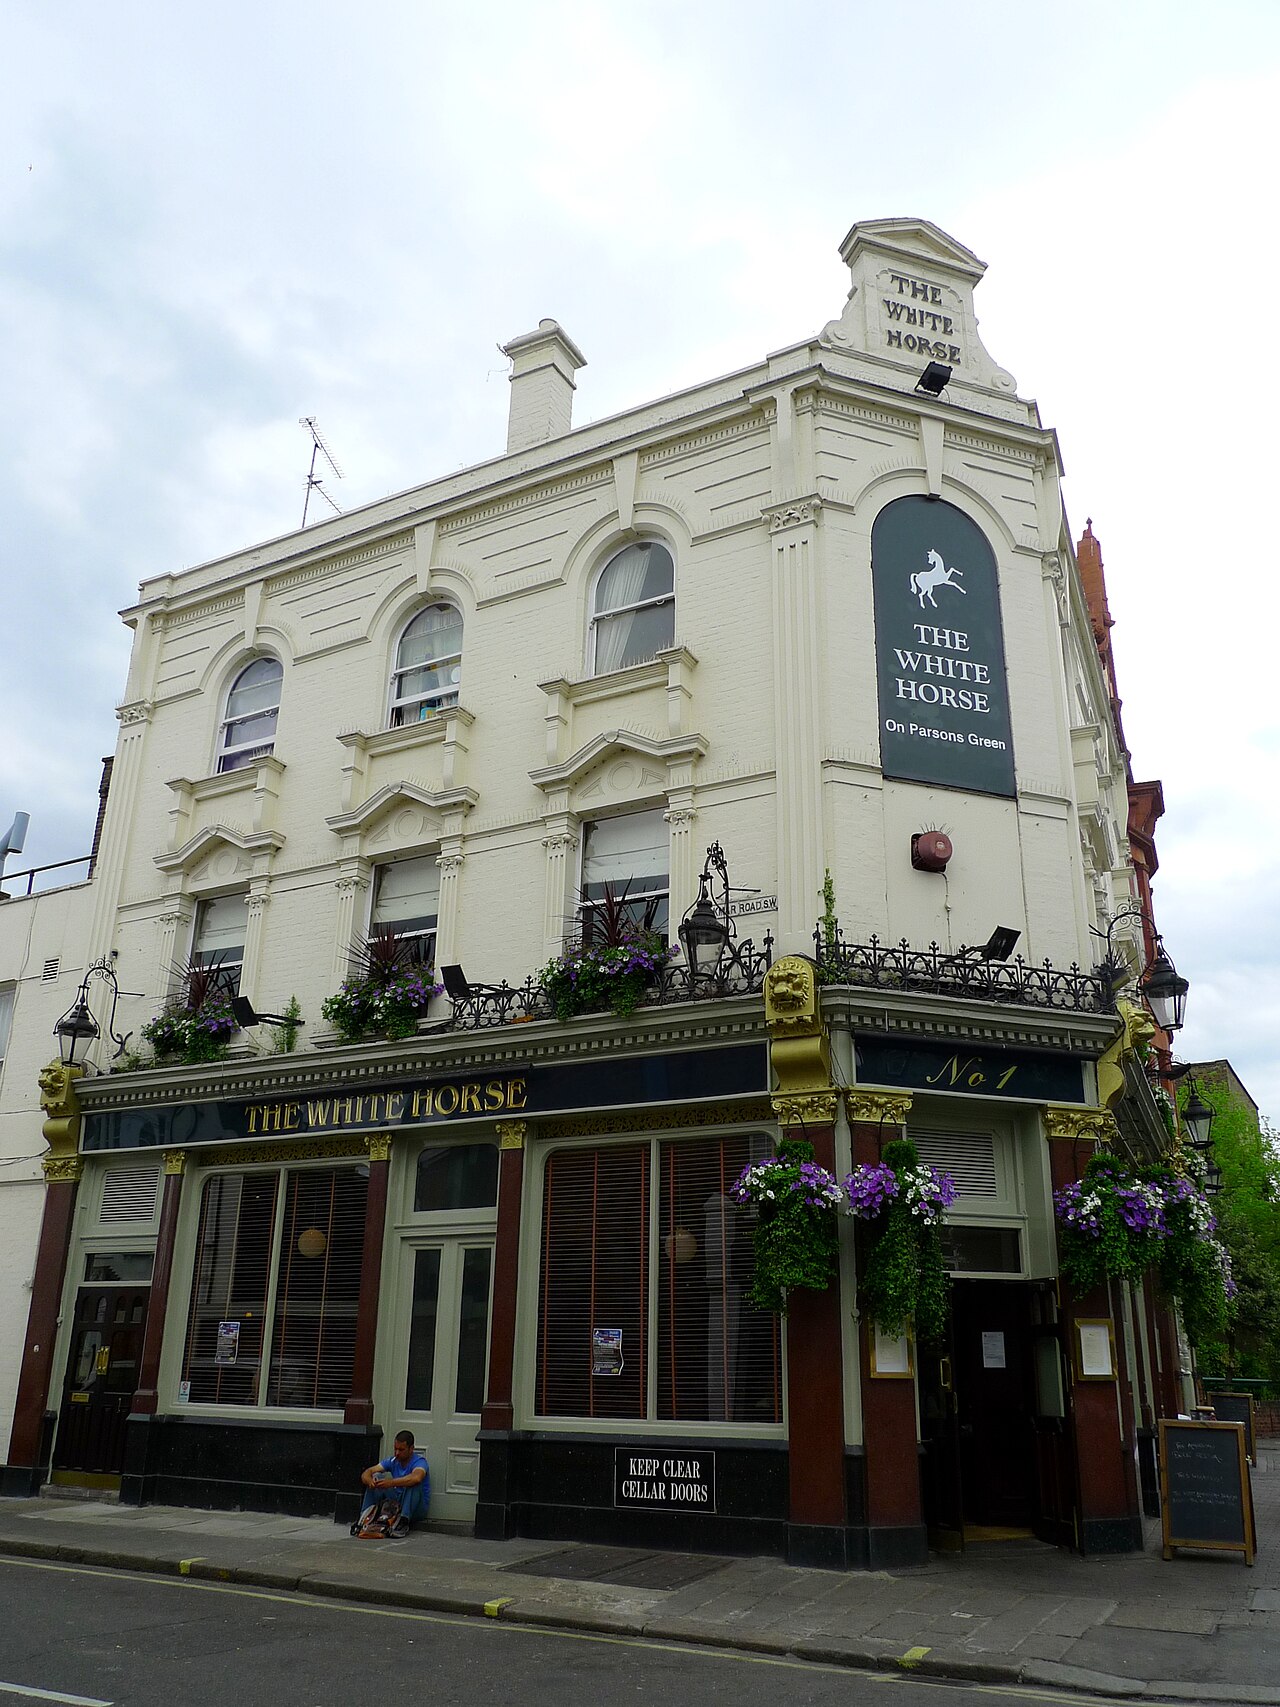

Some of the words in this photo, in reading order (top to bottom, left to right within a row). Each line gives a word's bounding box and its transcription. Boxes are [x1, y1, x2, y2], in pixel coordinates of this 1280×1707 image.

[890, 274, 943, 305] THE
[883, 298, 954, 335] WHITE
[886, 329, 961, 364] HORSE
[913, 624, 970, 652] THE
[893, 648, 991, 684] WHITE
[895, 677, 990, 713] HORSE
[885, 719, 905, 734] On
[909, 723, 965, 743] Parsons
[967, 733, 1006, 751] Green
[925, 1054, 987, 1087] No
[996, 1065, 1019, 1089] 1
[244, 1100, 300, 1133] THE
[307, 1091, 404, 1127] WHITE
[411, 1078, 528, 1118] HORSE
[629, 1457, 660, 1477] KEEP
[663, 1459, 701, 1479] CLEAR
[622, 1480, 666, 1500] CELLAR
[670, 1482, 708, 1503] DOORS
